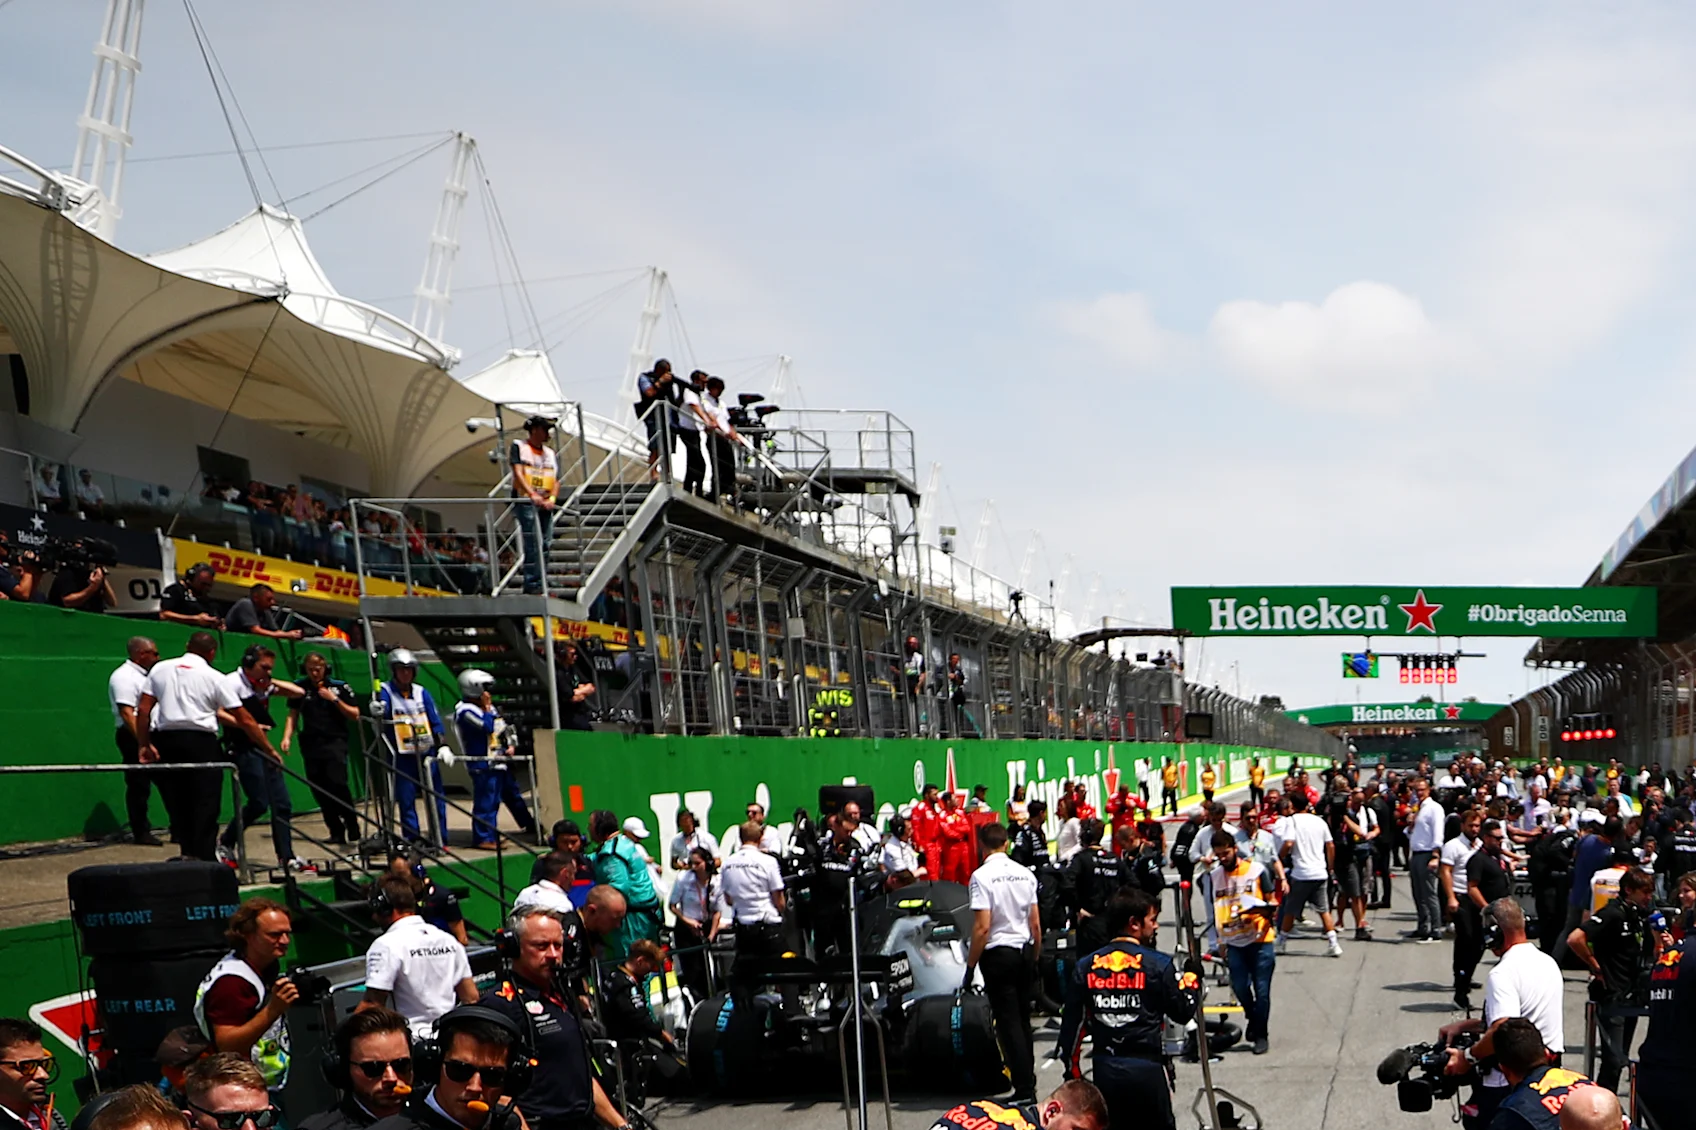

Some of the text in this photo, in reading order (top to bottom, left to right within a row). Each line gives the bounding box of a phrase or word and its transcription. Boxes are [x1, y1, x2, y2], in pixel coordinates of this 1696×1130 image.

[207, 551, 271, 583] DHL
[1208, 596, 1628, 631] Heineken #ObrigadoSenna
[1352, 705, 1438, 722] Heineken
[108, 910, 153, 926] FRONT
[186, 904, 241, 921] LEFT FRO
[1117, 971, 1145, 990] Bull
